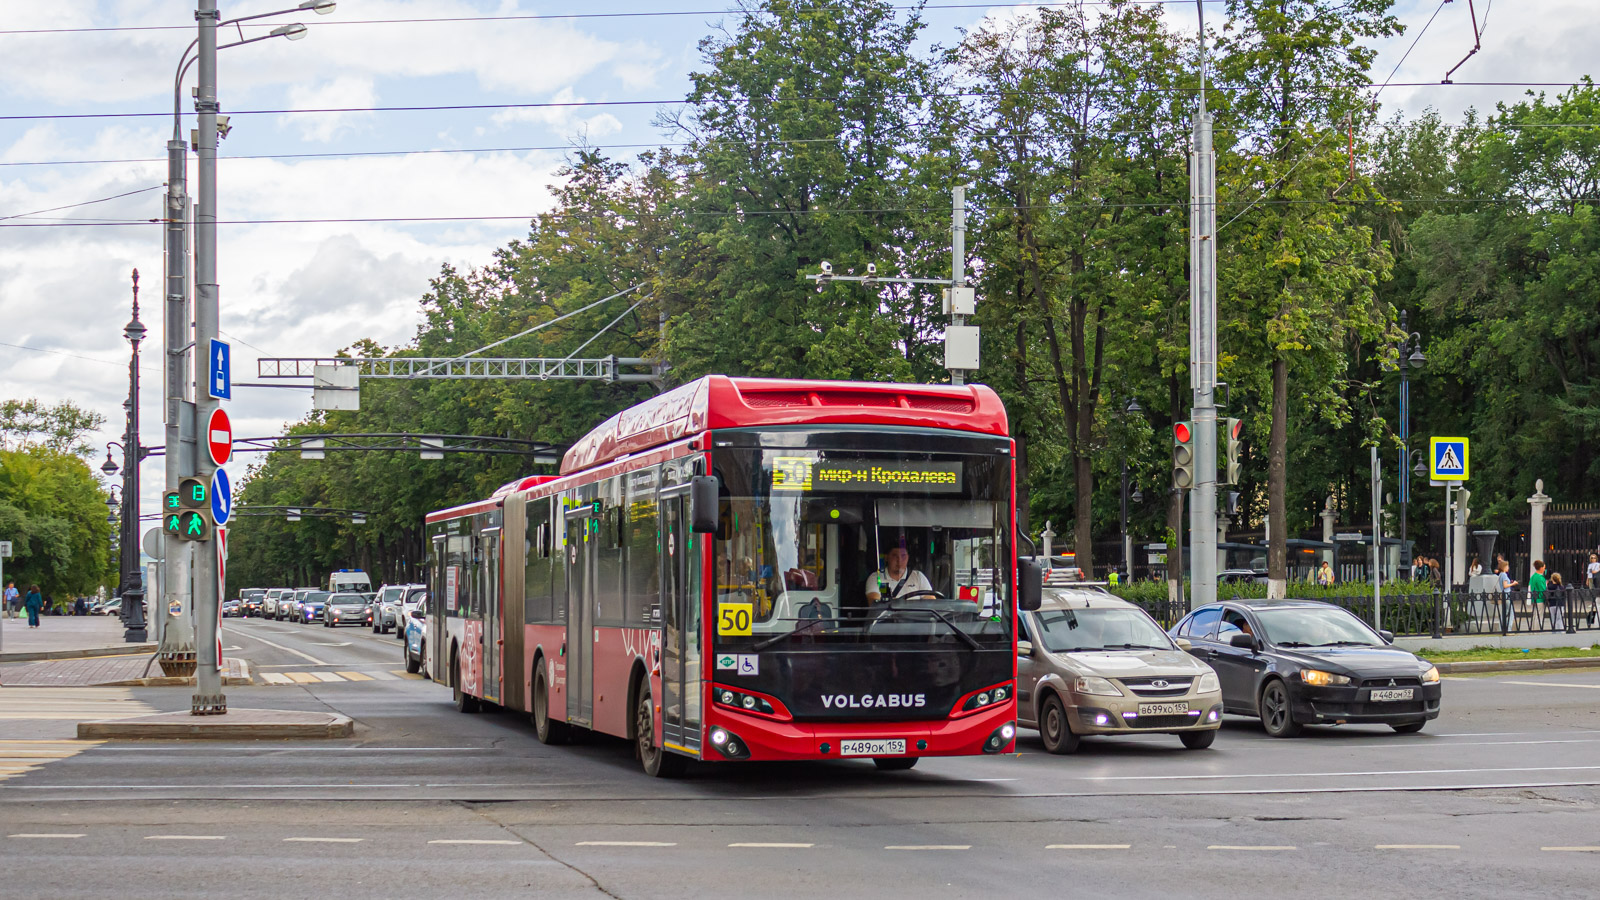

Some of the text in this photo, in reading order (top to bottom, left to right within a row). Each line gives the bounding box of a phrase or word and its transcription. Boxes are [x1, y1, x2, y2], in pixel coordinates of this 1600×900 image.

[777, 460, 806, 484] 50
[819, 466, 956, 485] мкр-н Крохалева
[721, 609, 750, 631] 50
[821, 694, 926, 708] VOLGABUS
[886, 741, 903, 750] 159
